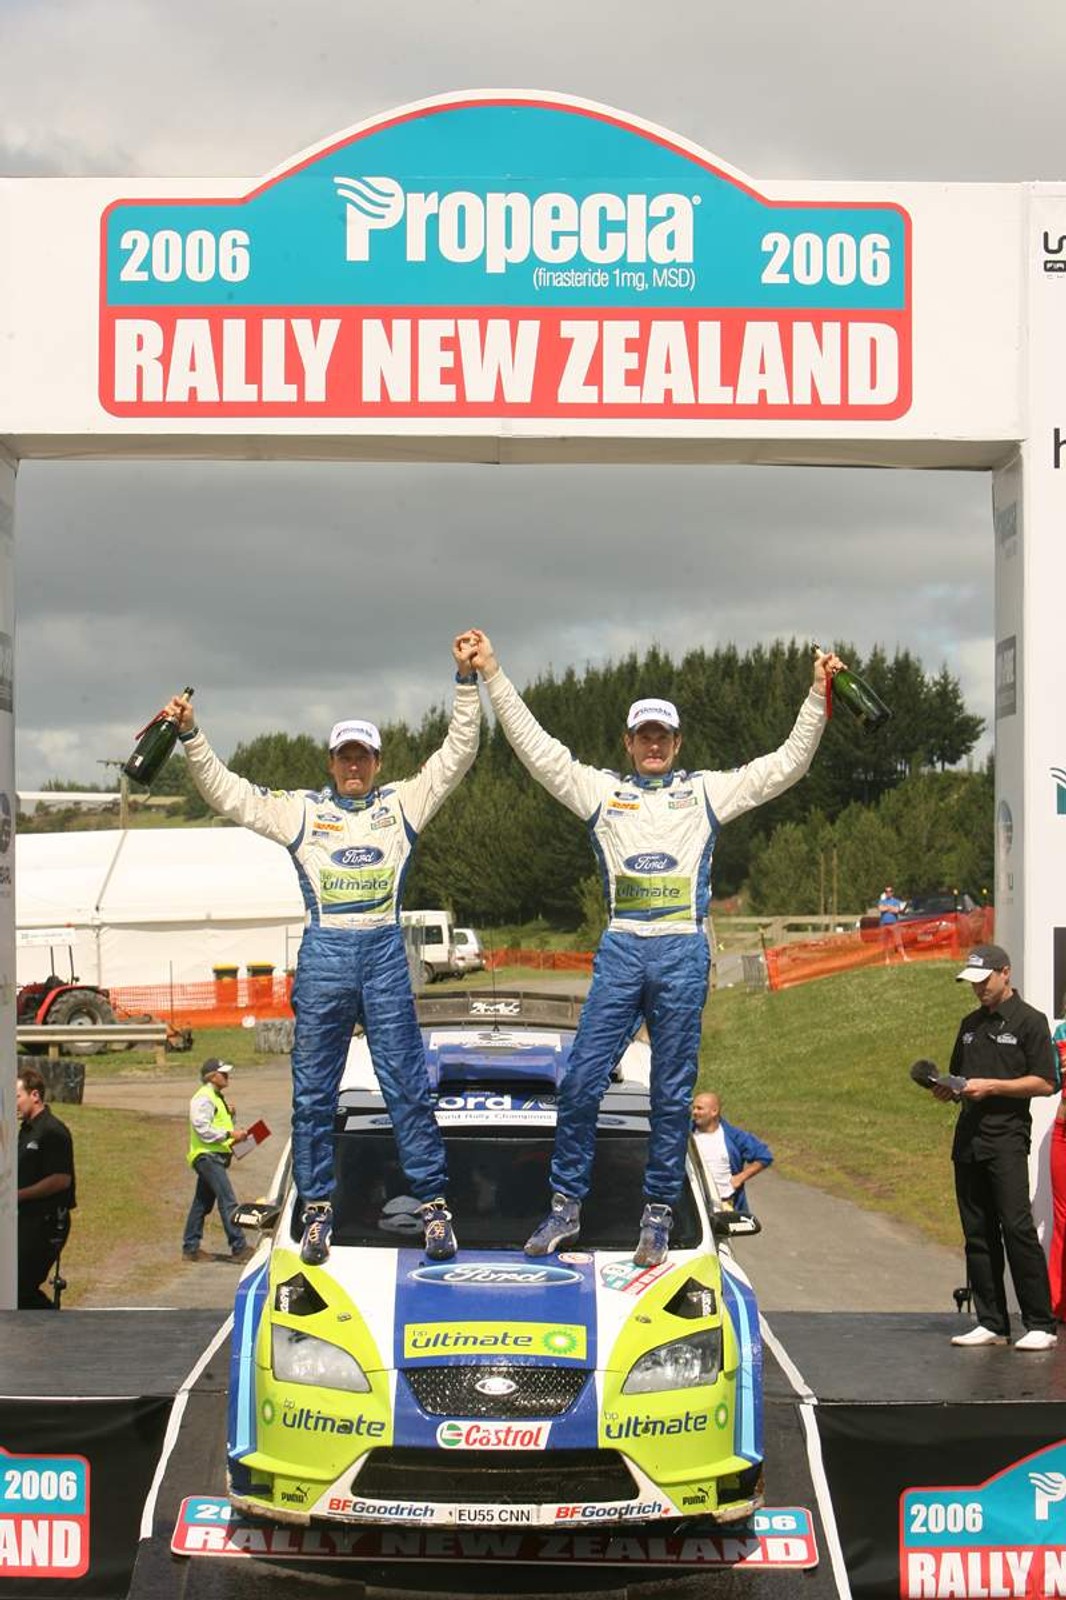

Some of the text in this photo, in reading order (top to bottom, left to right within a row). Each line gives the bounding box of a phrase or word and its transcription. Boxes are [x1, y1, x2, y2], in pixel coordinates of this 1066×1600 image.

[333, 176, 695, 275] Propecia
[119, 229, 251, 283] 2006
[760, 231, 891, 286] 2006
[533, 267, 696, 292] (finasteride 1mg, MSD)
[114, 318, 900, 406] RALLY NEW ZEALAND
[443, 1264, 549, 1283] Ford
[411, 1332, 533, 1350] ultimate
[282, 1407, 387, 1438] ultimate
[464, 1424, 543, 1447] Castrol
[605, 1410, 708, 1440] ultimate
[4, 1469, 78, 1502] 2006
[328, 1498, 436, 1517] BFGoodrich
[458, 1508, 531, 1523] EU55 CNN
[555, 1500, 662, 1519] BFGoodrich
[910, 1502, 984, 1534] 2006
[184, 1526, 809, 1563] RALLY NEW ZEALAND
[907, 1551, 1034, 1599] RALLY
